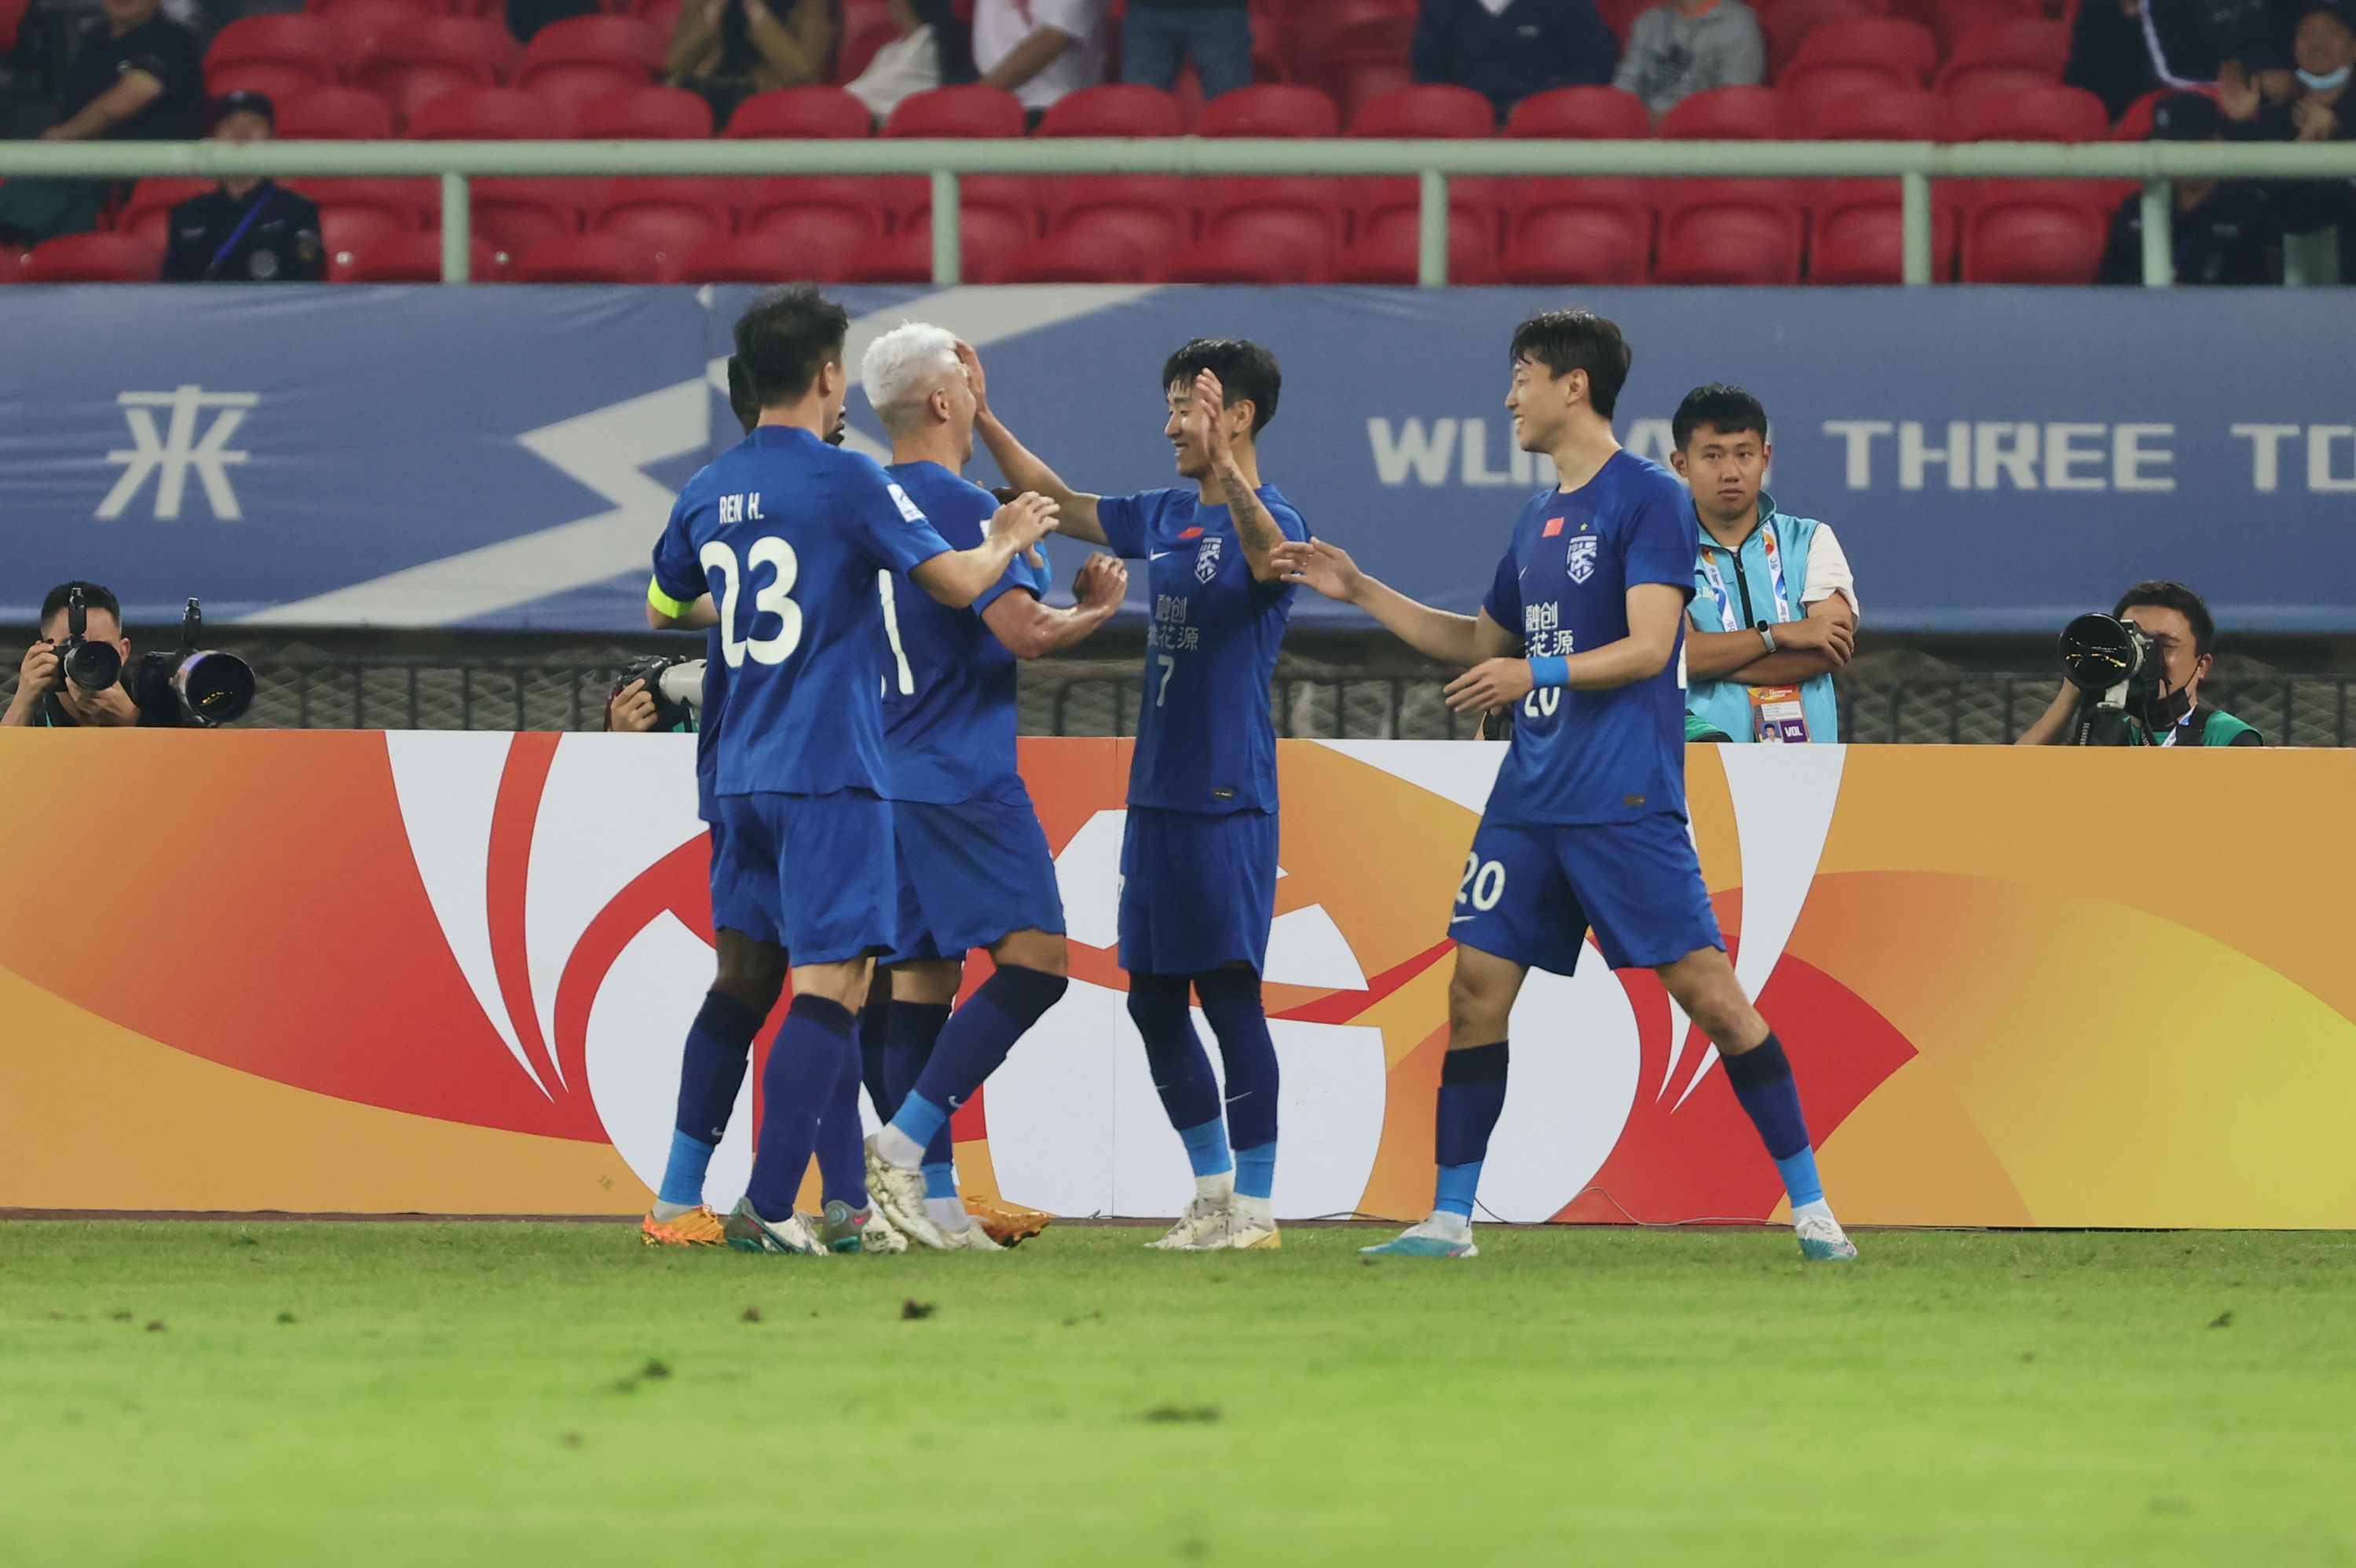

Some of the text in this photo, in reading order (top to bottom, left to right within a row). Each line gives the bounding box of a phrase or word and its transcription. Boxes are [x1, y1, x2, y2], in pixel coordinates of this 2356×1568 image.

[1822, 420, 2176, 490] THREE
[719, 492, 765, 524] REN H.
[700, 535, 803, 668] 23
[1525, 601, 1558, 633] 融创
[1525, 630, 1574, 658] 花源
[1156, 654, 1175, 707] 7
[1784, 726, 1804, 737] VOL
[1456, 850, 1506, 912] 20
